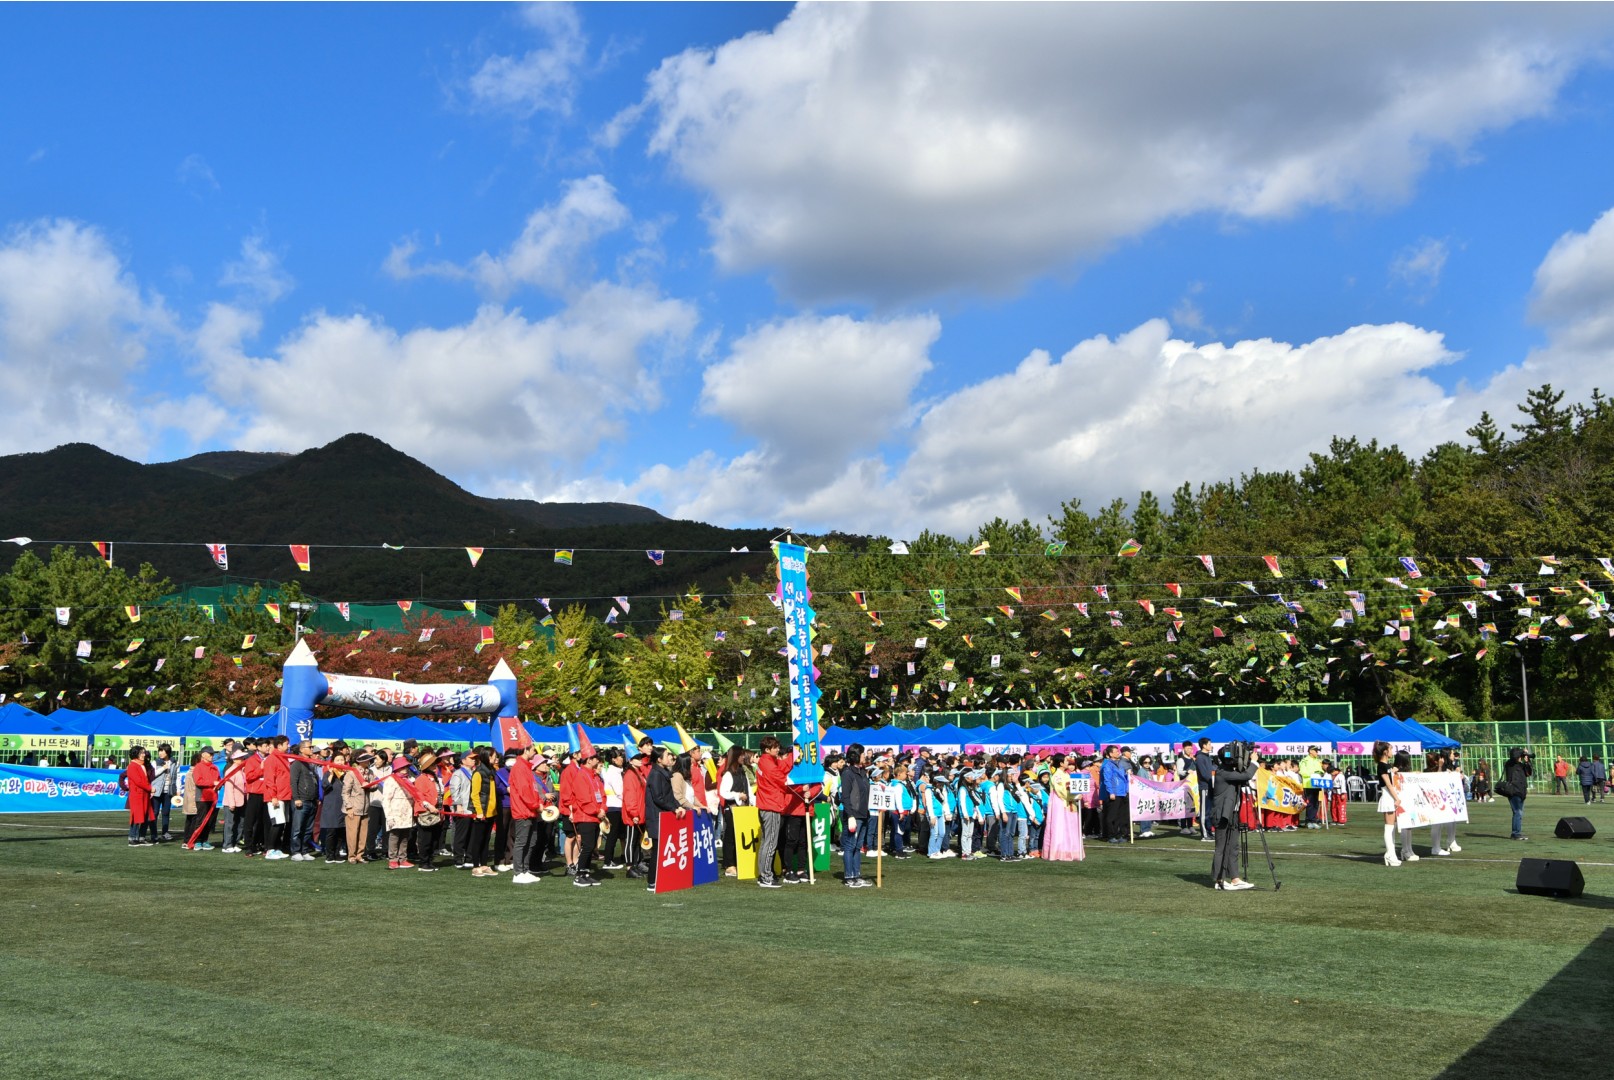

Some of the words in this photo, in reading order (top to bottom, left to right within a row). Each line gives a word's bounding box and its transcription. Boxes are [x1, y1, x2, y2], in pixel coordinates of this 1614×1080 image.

[376, 687, 420, 709] 행복한
[422, 692, 447, 712] 마을
[802, 674, 814, 734] 공동체
[30, 738, 81, 748] LH뜨란채
[25, 779, 57, 796] 미래를
[82, 781, 117, 795] 변화의
[872, 794, 891, 808] 좌1동
[662, 827, 690, 871] 소통
[692, 824, 714, 865] 화합
[812, 817, 828, 855] 복
